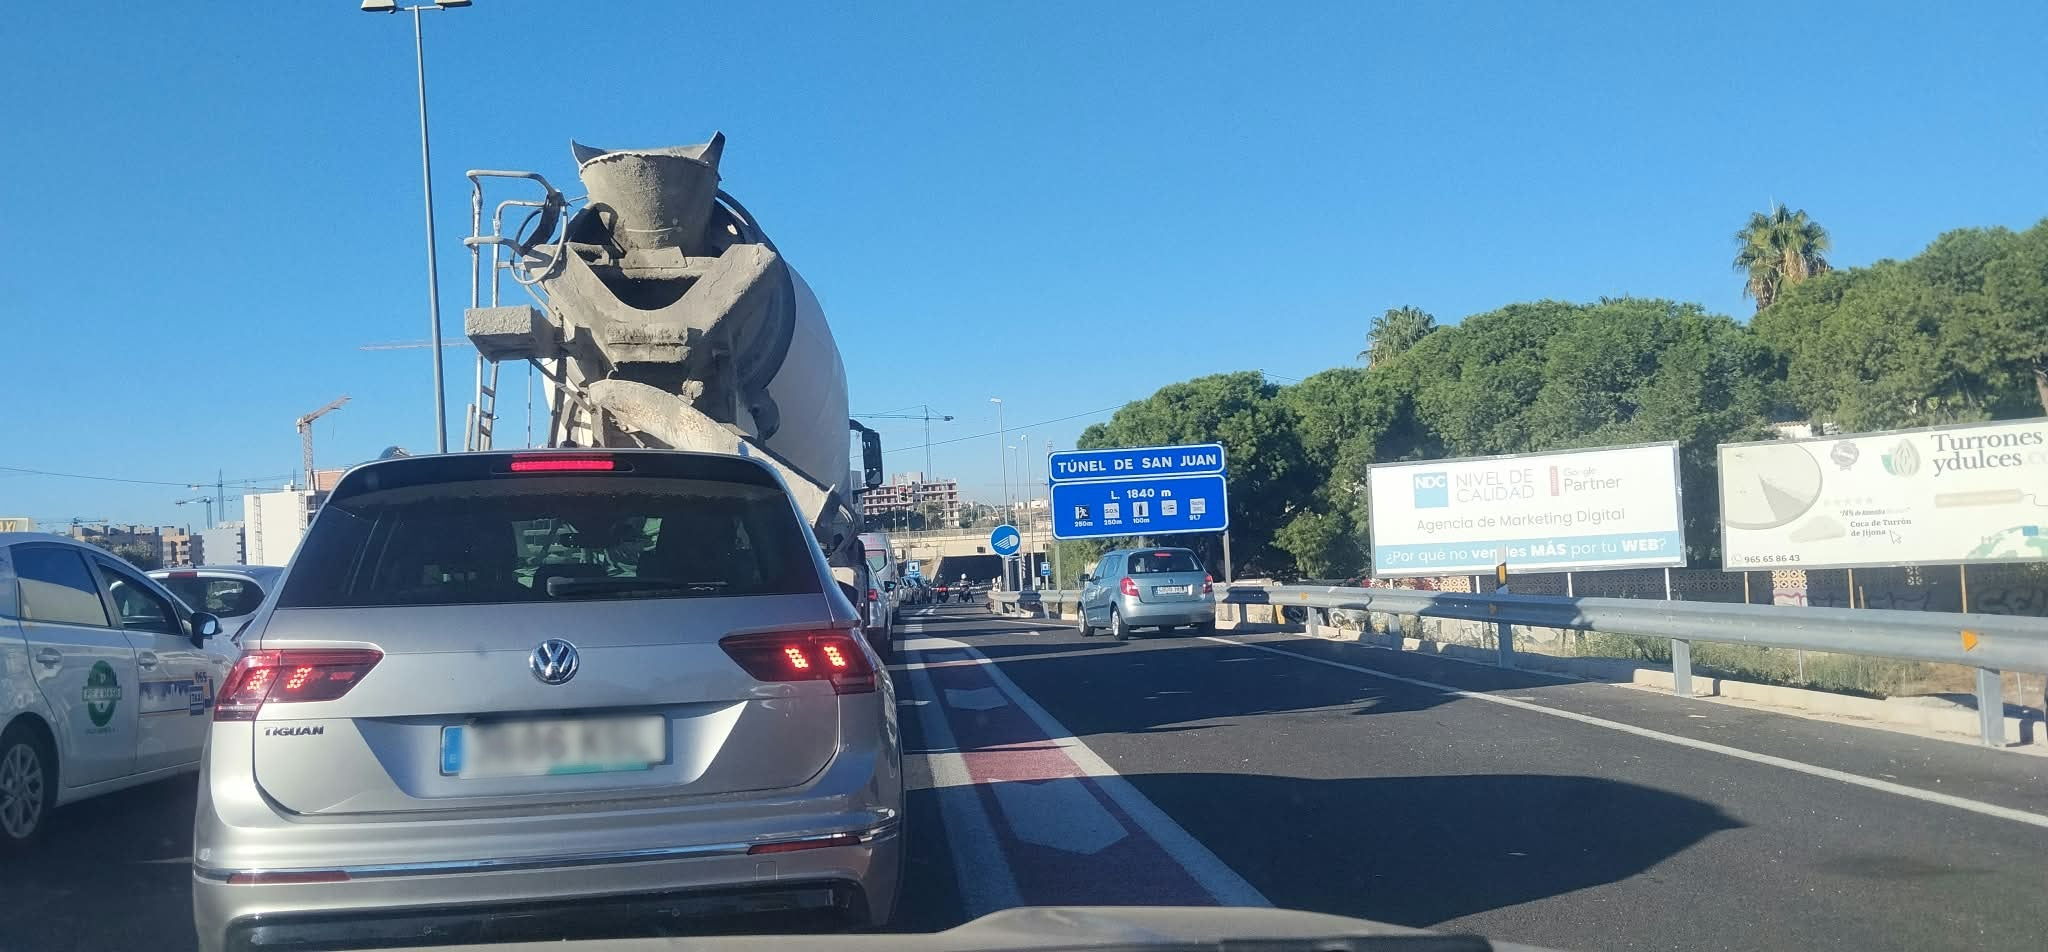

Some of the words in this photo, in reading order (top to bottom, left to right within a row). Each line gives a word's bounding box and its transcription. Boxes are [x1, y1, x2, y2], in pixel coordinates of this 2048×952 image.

[1930, 431, 2044, 452] Turrones
[1058, 459, 1106, 473] TÚNEL
[1114, 458, 1134, 470] DE
[1142, 456, 1172, 468] SAN
[1180, 454, 1216, 467] JUAN
[1415, 475, 1446, 488] NDC
[1456, 471, 1504, 488] NIVEL
[1509, 468, 1534, 484] DE
[1564, 476, 1622, 492] Partner
[1110, 490, 1120, 500] L.
[1126, 488, 1154, 498] 1840
[1456, 484, 1535, 502] CALIDAD
[0, 520, 16, 532] AXI
[1417, 519, 1473, 534] Agencia
[1478, 516, 1496, 528] de
[1500, 512, 1572, 526] Marketing
[1577, 508, 1625, 524] Digital
[1882, 517, 1912, 525] Turrón
[1386, 551, 1413, 564] ¿Por
[1420, 549, 1445, 563] qué
[1450, 550, 1467, 559] no
[1531, 541, 1567, 556] MÁS
[1571, 543, 1596, 558] por
[1602, 541, 1617, 553] tu
[1622, 538, 1667, 552] WEB?
[1789, 554, 1800, 562] 43
[264, 726, 324, 736] TIGUAN
